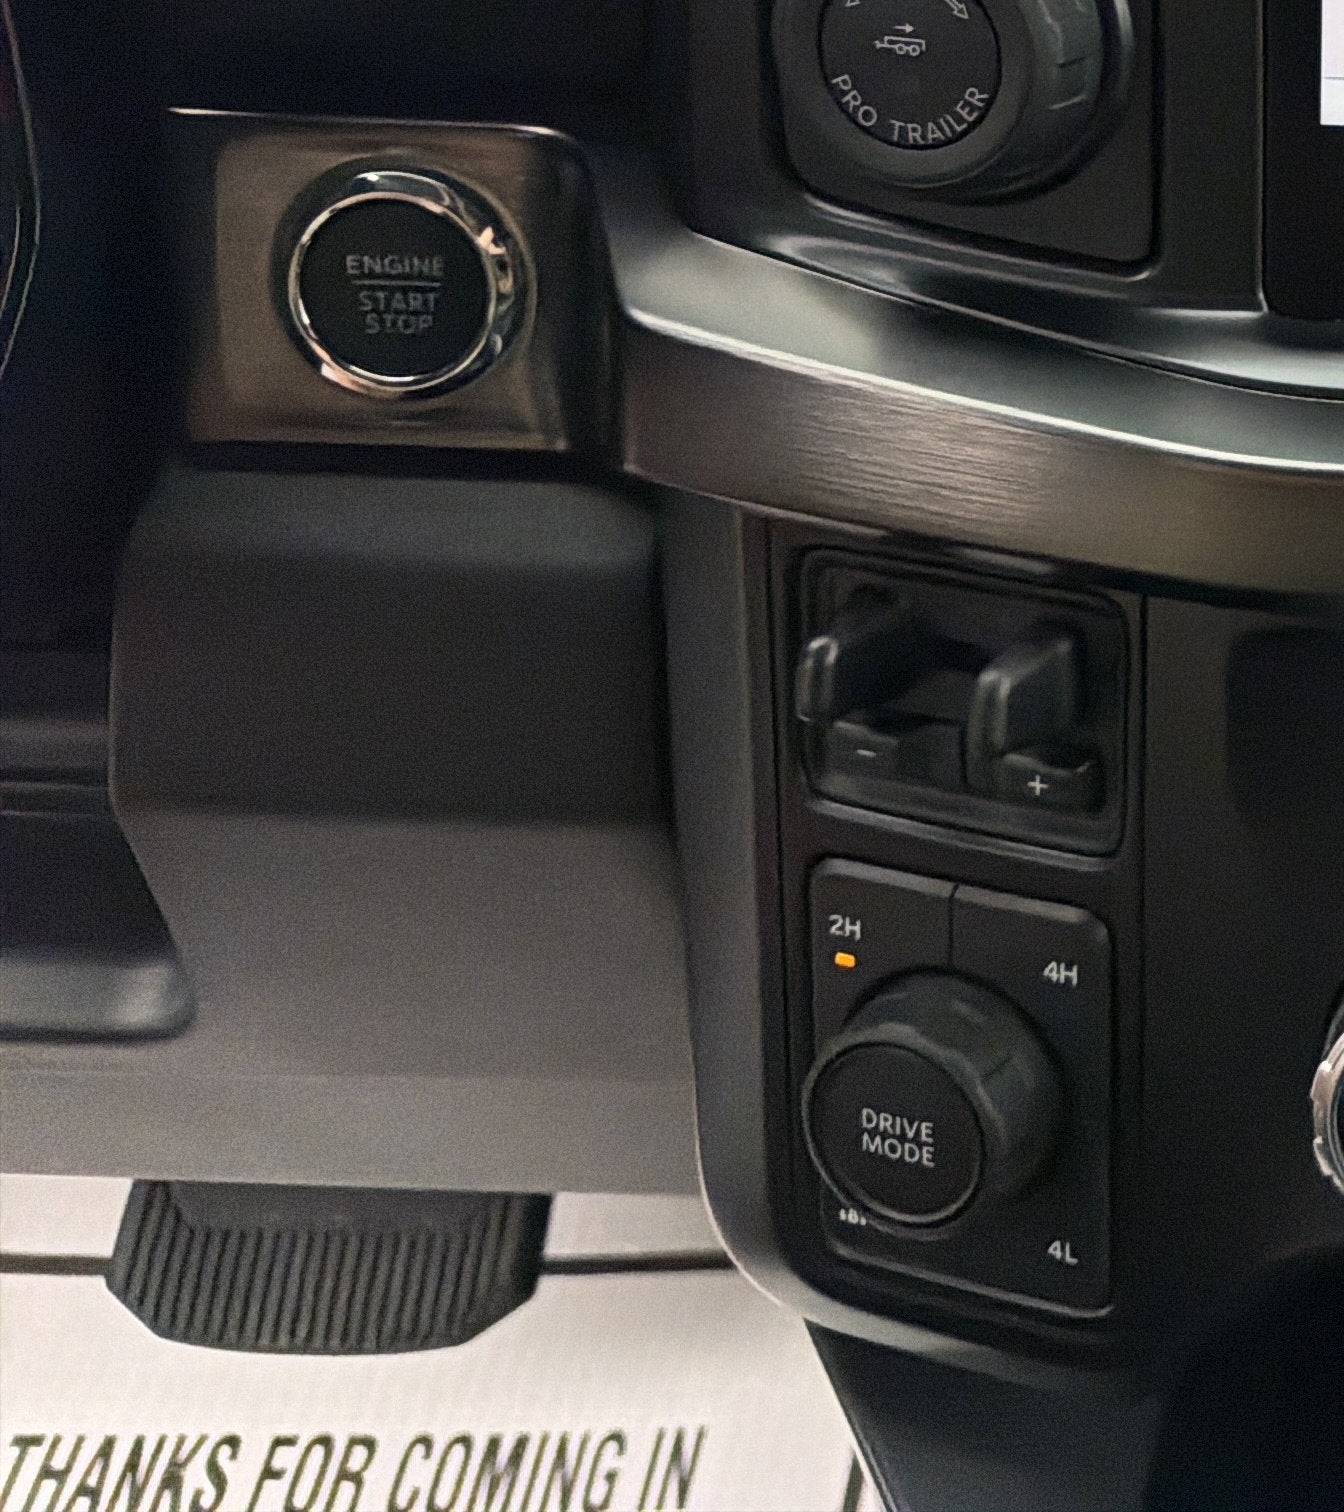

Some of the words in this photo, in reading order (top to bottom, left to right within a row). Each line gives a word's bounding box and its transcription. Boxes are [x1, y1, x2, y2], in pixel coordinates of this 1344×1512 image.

[832, 74, 877, 128] PRO
[890, 86, 990, 145] TRAILER
[346, 254, 446, 276] ENGINE
[359, 290, 440, 312] START
[365, 313, 433, 335] STOP
[828, 914, 862, 940] 2H
[1043, 960, 1079, 987] 4H
[861, 1107, 934, 1144] DRIVE
[861, 1132, 936, 1168] MODE
[1047, 1238, 1079, 1265] 4L
[0, 1432, 242, 1512] THANKS
[254, 1432, 379, 1512] FOR
[389, 1426, 628, 1512] COMING
[638, 1425, 708, 1512] IN
